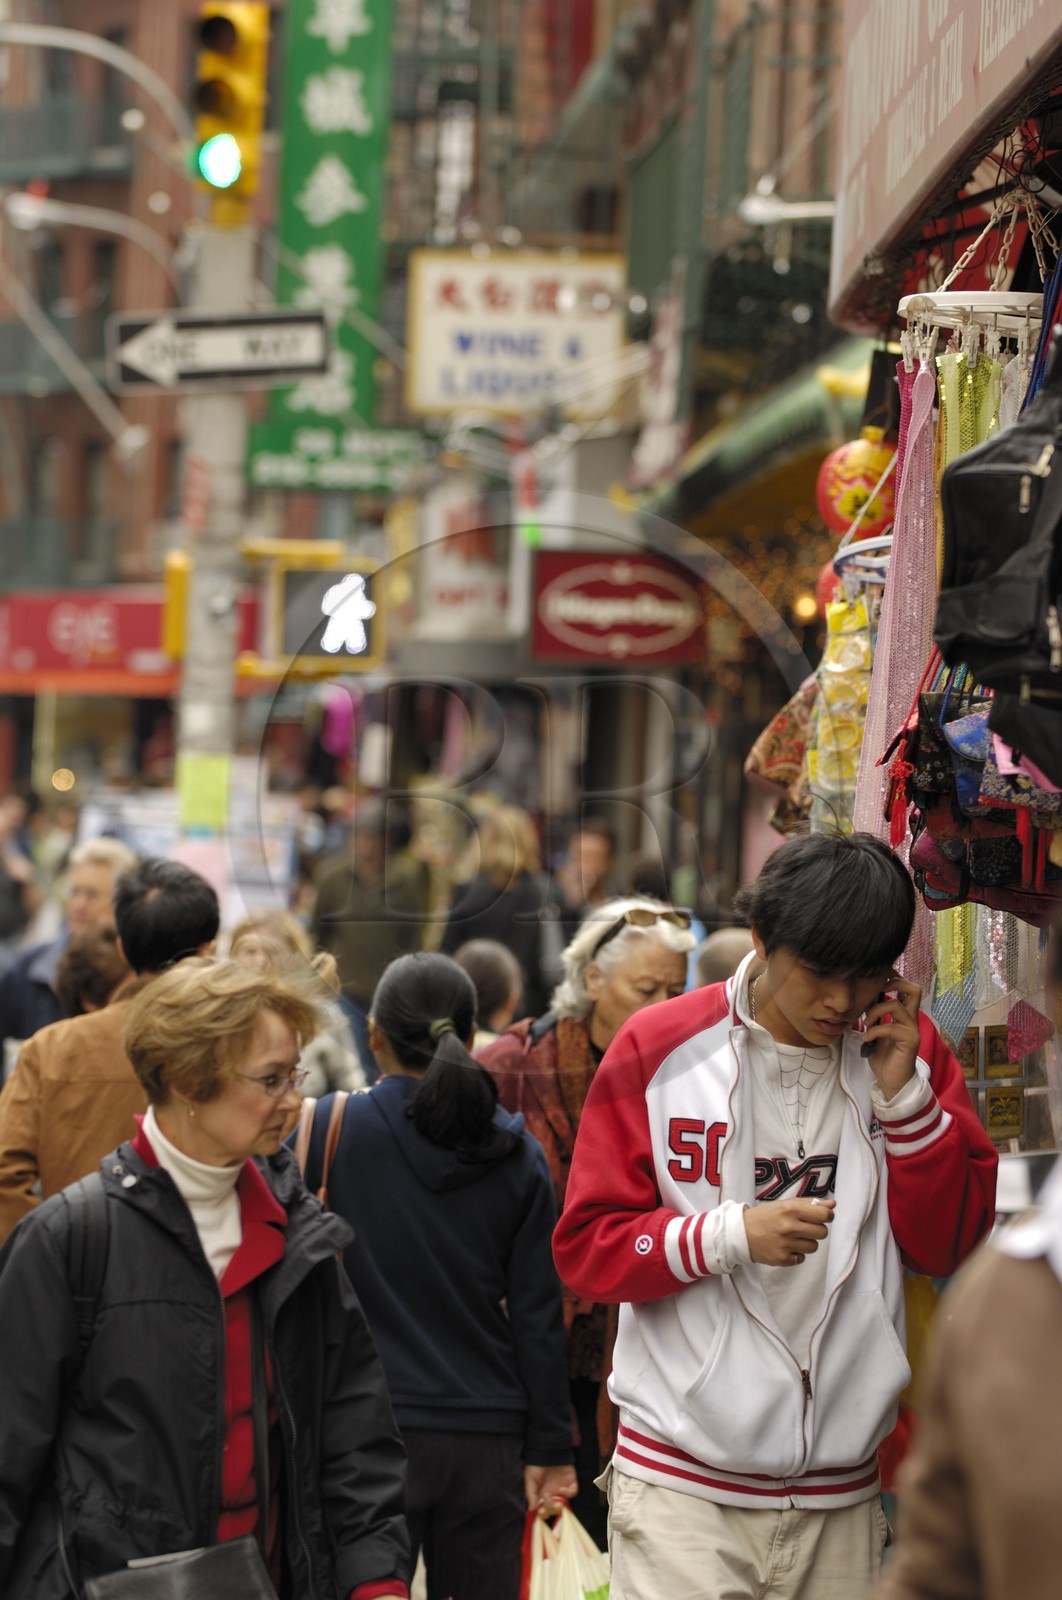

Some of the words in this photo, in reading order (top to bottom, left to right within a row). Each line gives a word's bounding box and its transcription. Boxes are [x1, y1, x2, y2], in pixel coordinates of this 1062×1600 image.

[938, 9, 963, 127] RETAIL
[144, 336, 199, 370] ONE
[241, 329, 308, 366] WAY
[456, 330, 542, 358] WINE
[755, 1154, 838, 1200] PYD
